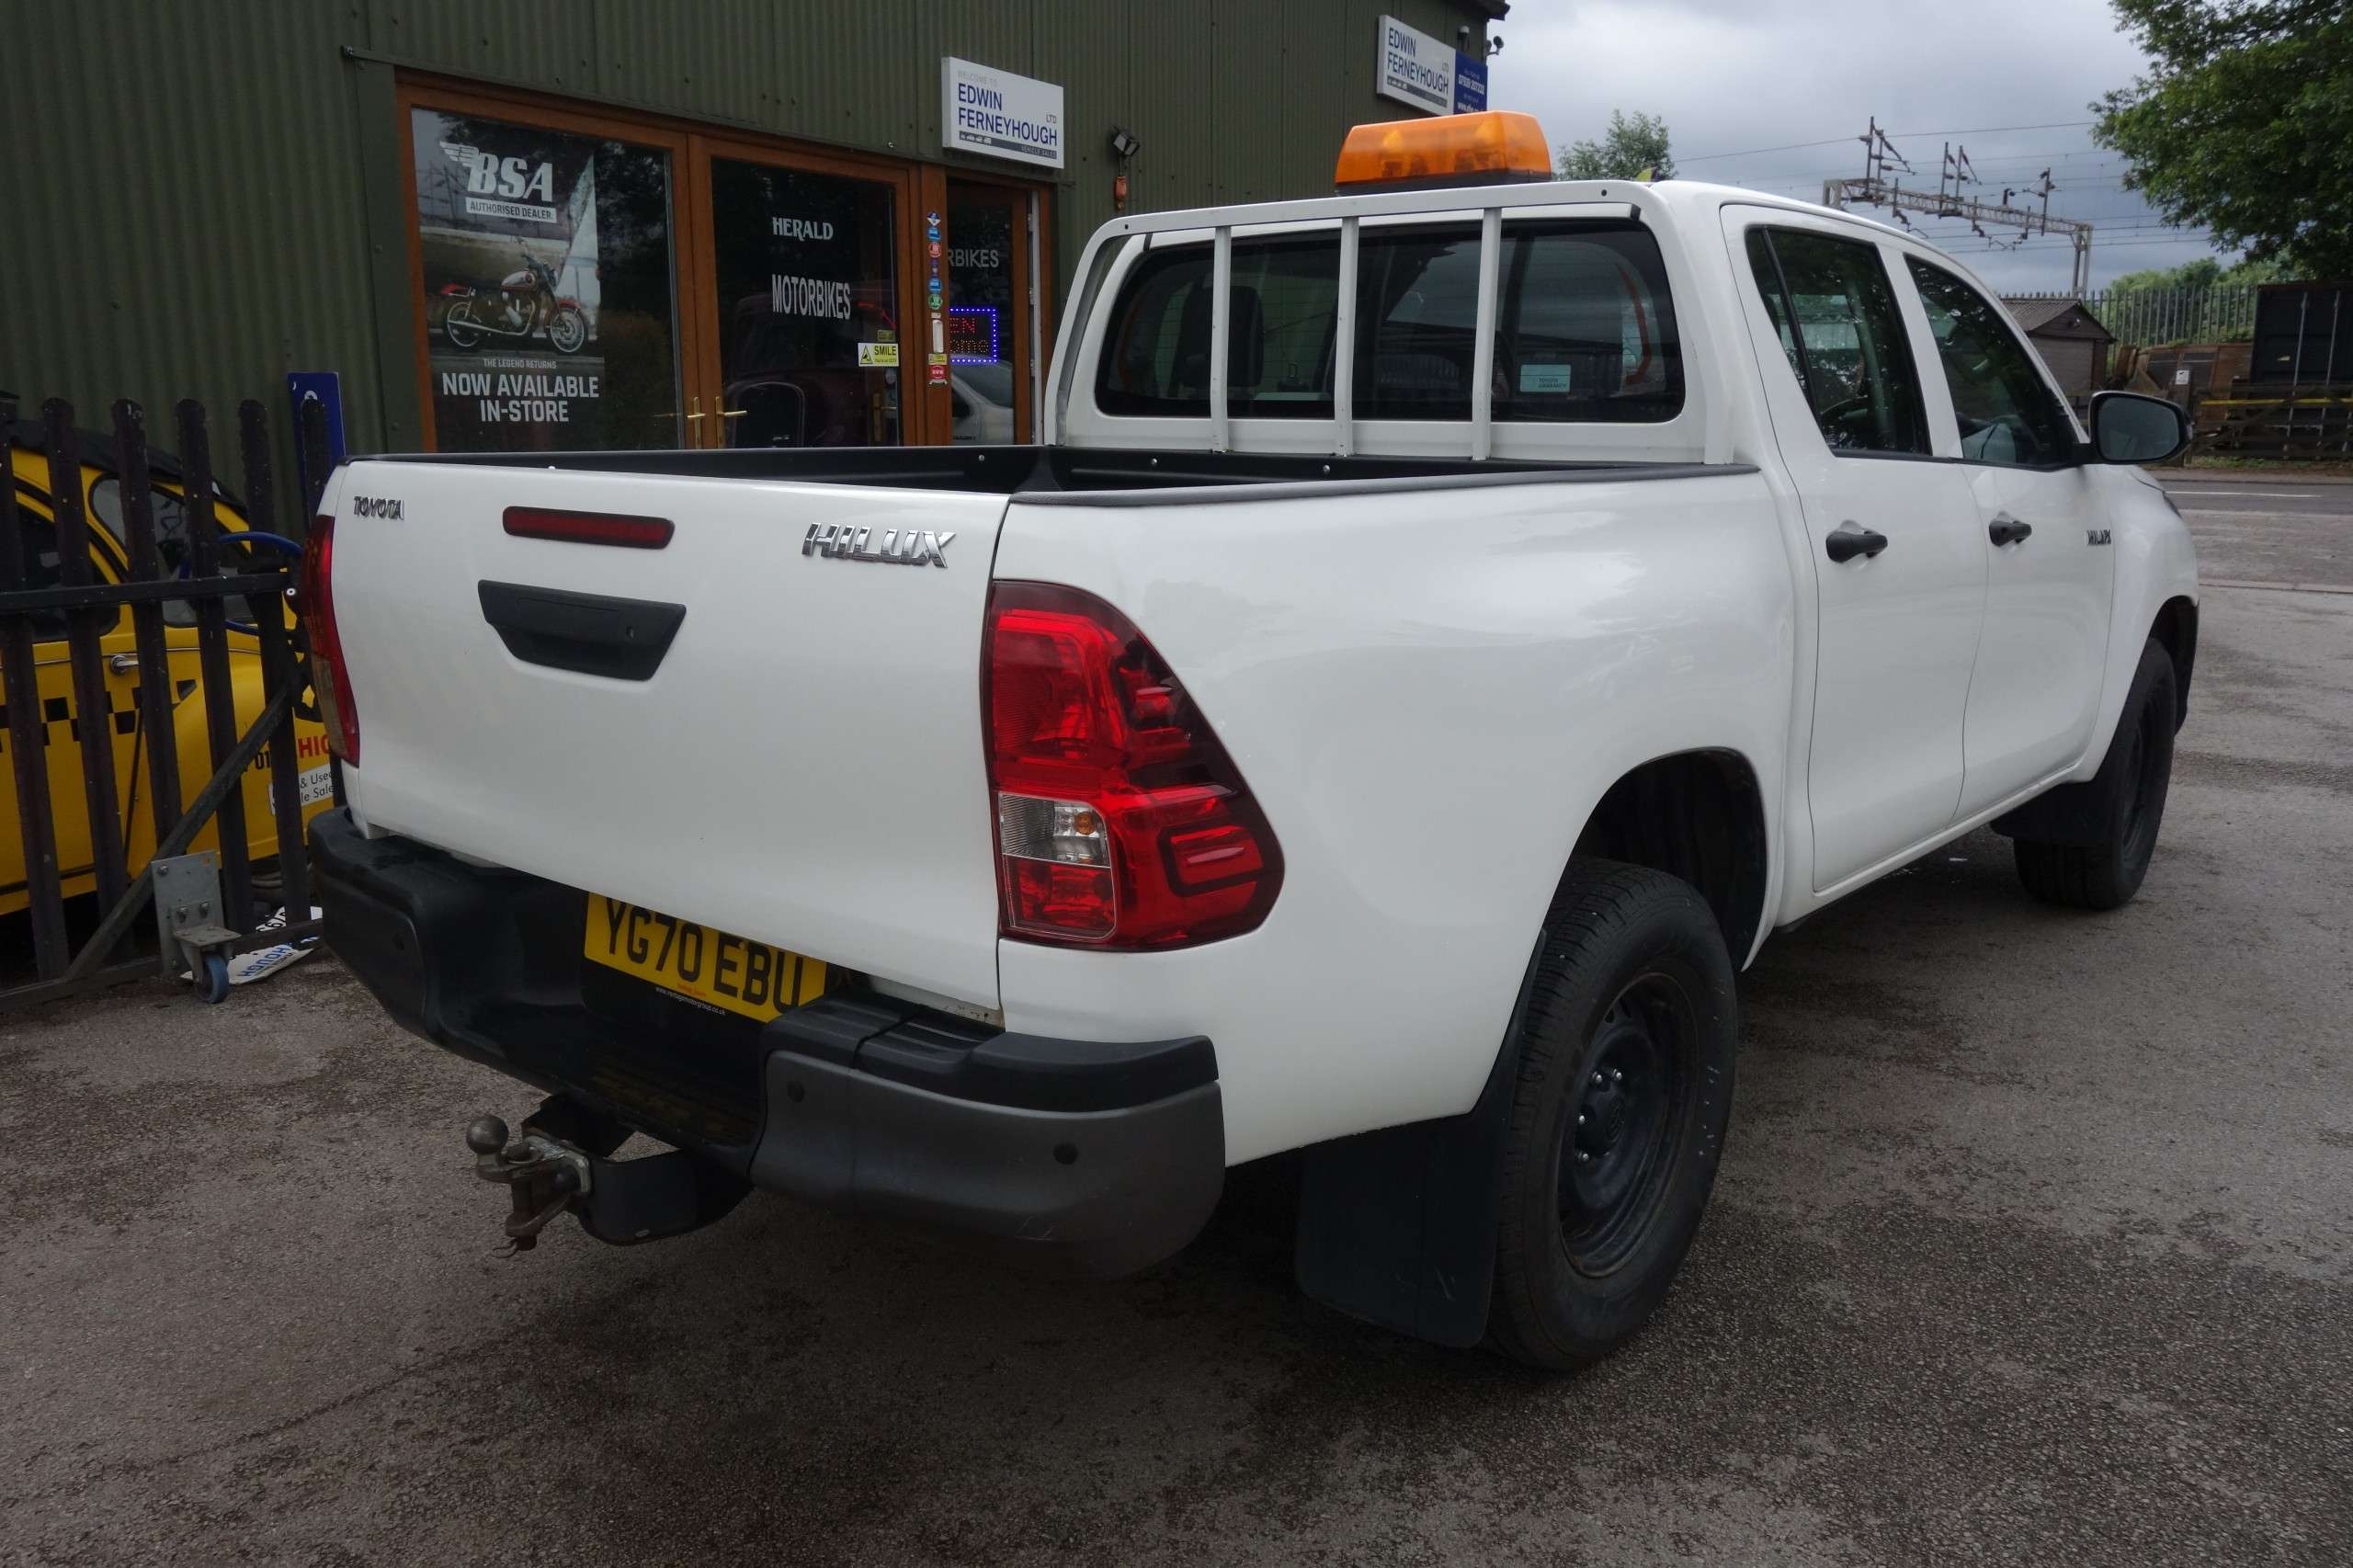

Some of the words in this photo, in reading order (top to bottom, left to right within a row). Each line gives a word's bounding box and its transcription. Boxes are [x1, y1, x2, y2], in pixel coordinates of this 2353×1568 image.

[1388, 28, 1416, 56] EDWIN
[1387, 51, 1449, 96] FERNEYHOUGH
[958, 82, 1003, 111] EDWIN
[958, 107, 1058, 147] FERNEYHOUGH
[1045, 114, 1057, 124] LTD
[468, 152, 553, 202] BSA
[470, 200, 520, 217] AUTHORISED
[772, 216, 834, 242] HERALD
[772, 274, 851, 321] MOTORBIKES
[483, 358, 496, 368] THE
[498, 358, 525, 369] LEGEND
[526, 359, 557, 369] RETURNS
[874, 345, 897, 356] SMILE
[442, 372, 491, 396] NOW
[497, 374, 600, 398] AVAILABLE
[480, 400, 569, 423] IN-STORE
[353, 496, 404, 520] TOYOTA
[801, 522, 956, 569] HILUX
[606, 897, 703, 983] YG70
[713, 931, 803, 1012] EBU
